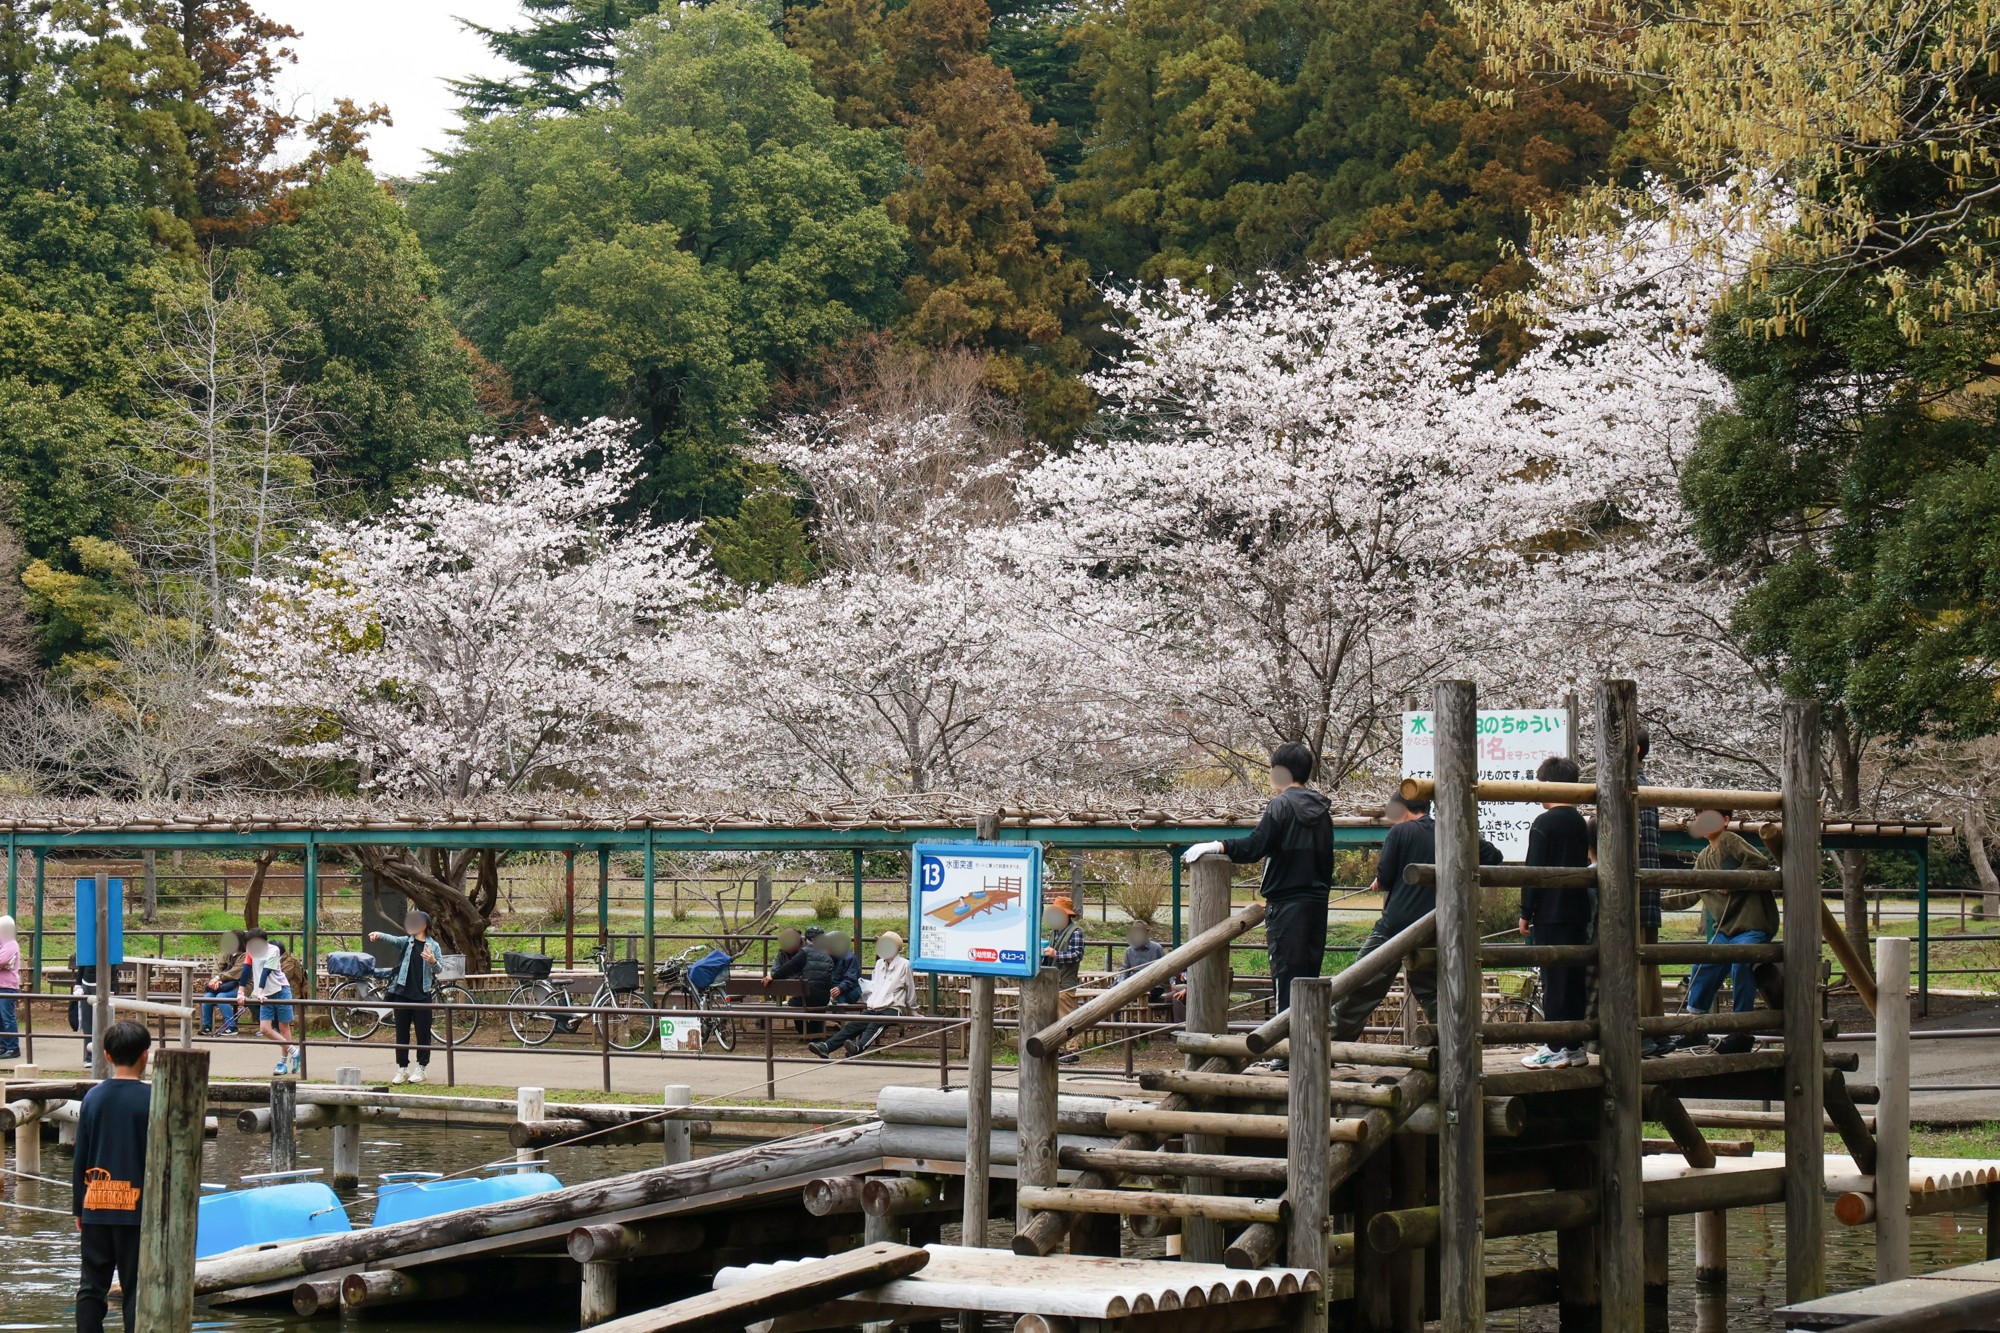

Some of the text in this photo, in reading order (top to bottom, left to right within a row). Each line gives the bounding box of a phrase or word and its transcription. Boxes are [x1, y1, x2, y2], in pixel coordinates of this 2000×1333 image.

[1478, 820, 1533, 831] しぶきや、くつ
[923, 864, 940, 885] 13
[1001, 952, 1024, 961] 水上コース
[662, 1023, 673, 1034] 12
